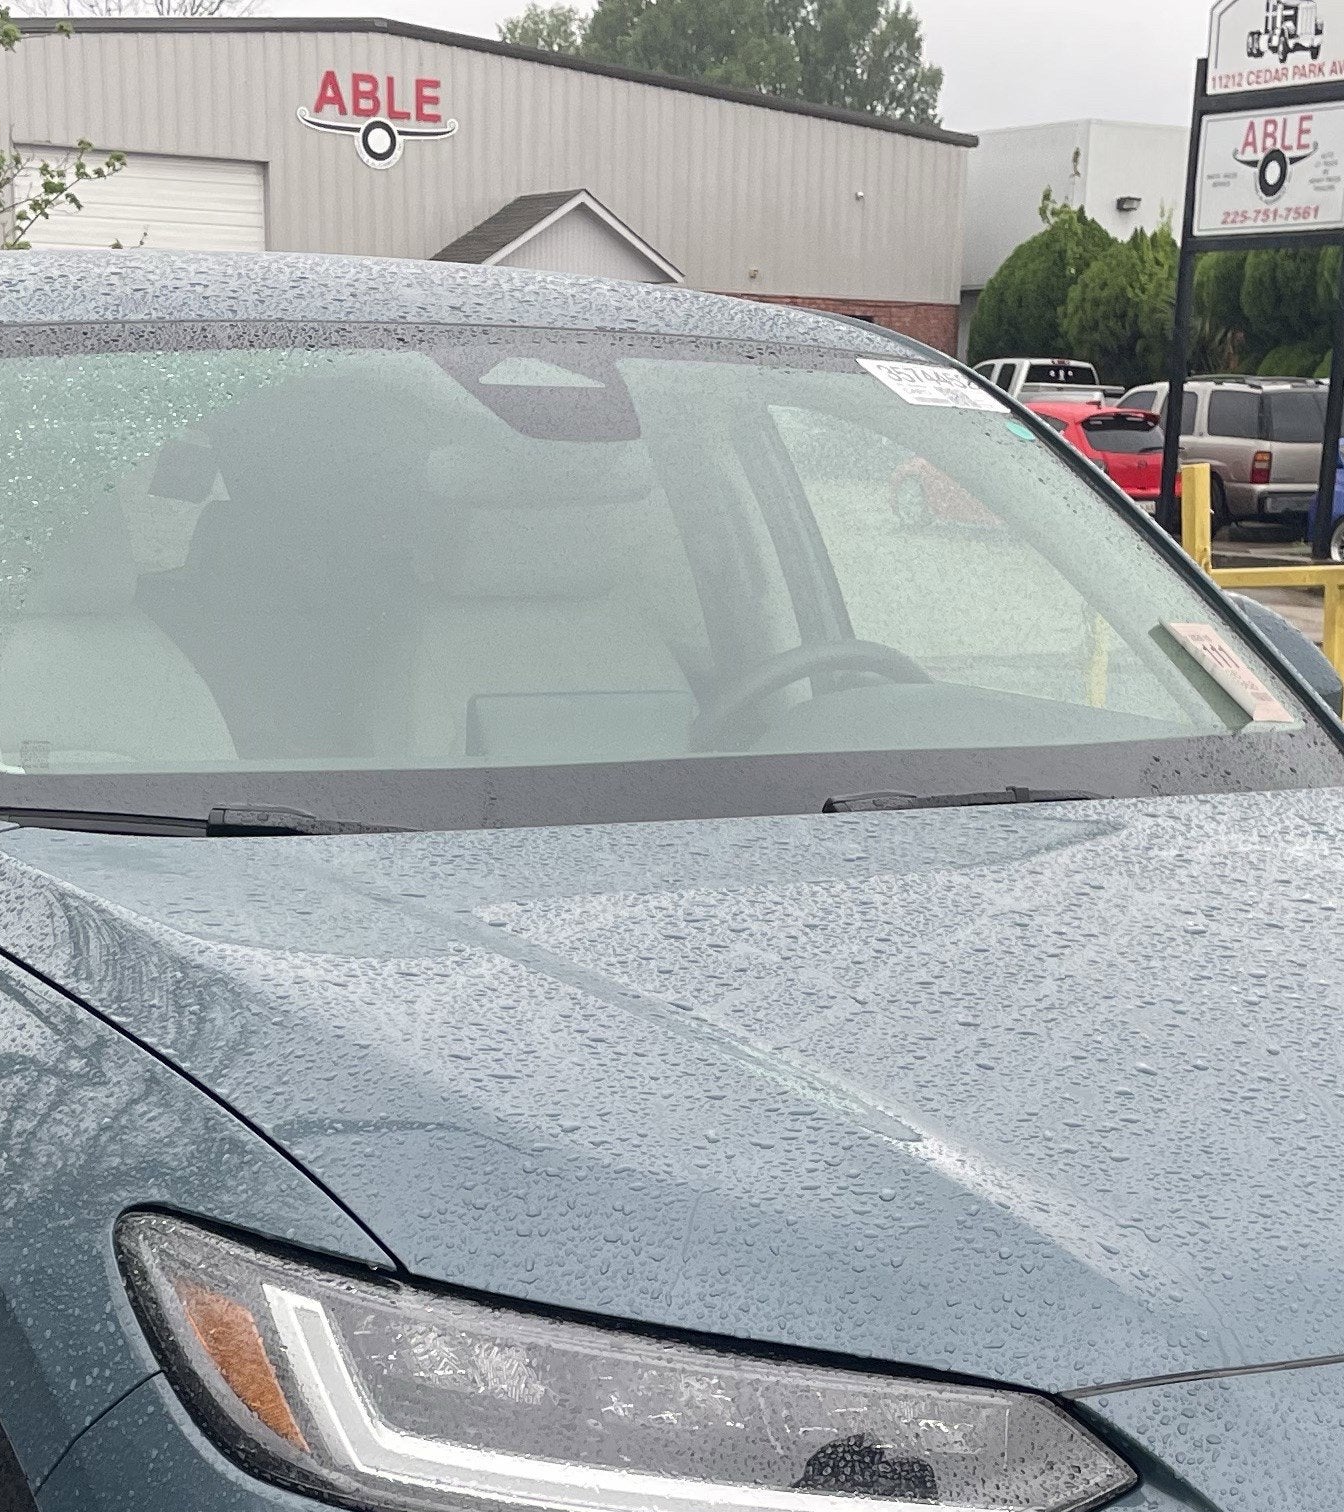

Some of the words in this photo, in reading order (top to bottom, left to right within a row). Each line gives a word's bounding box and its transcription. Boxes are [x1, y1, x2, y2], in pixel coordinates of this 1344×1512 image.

[1246, 66, 1289, 86] CEDAR
[1292, 61, 1325, 81] PARK
[313, 70, 442, 123] ABLE
[1241, 114, 1313, 155] ABLE
